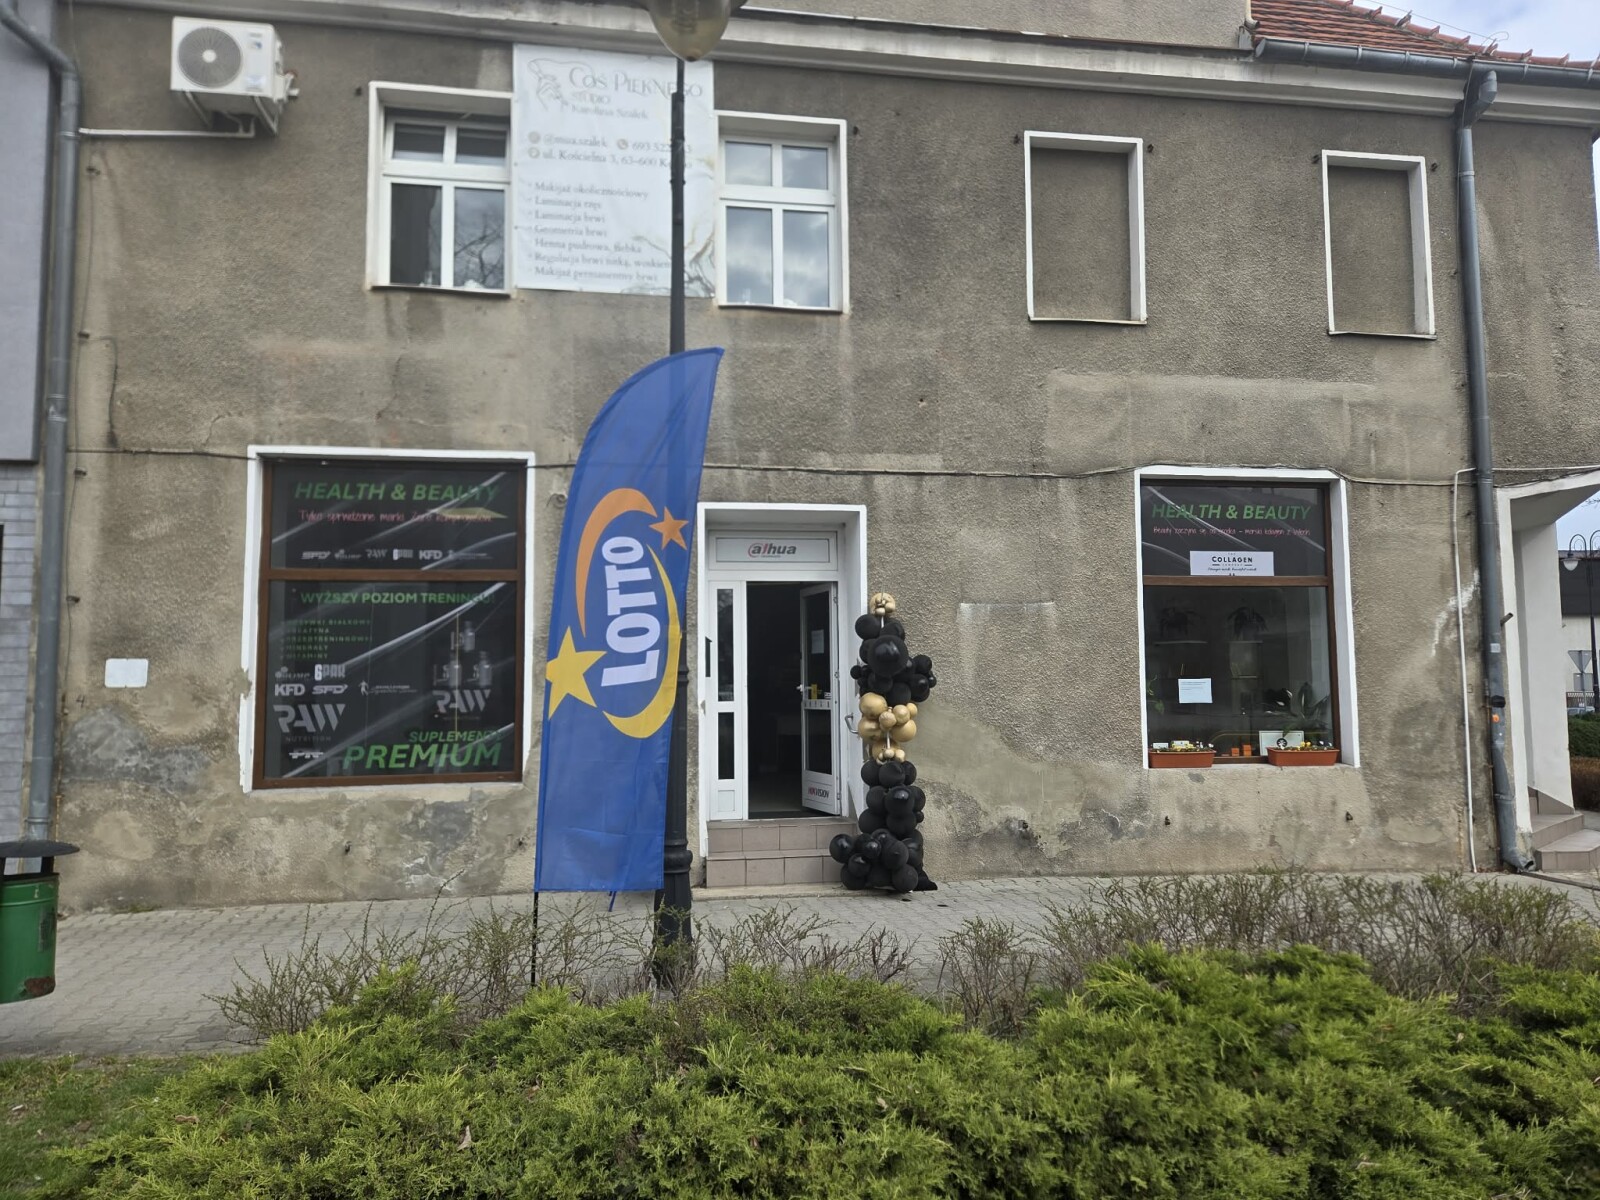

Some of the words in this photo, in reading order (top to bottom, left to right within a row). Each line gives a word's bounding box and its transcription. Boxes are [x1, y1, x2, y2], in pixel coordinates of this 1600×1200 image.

[294, 482, 385, 500] HEALTH
[391, 484, 406, 501] &
[412, 484, 499, 501] BEAUTY
[1151, 503, 1222, 519] HEALTH
[1226, 504, 1238, 519] &
[1243, 504, 1311, 520] BEAUTY
[419, 549, 443, 560] KFD
[361, 592, 417, 604] POZIOM
[601, 536, 661, 687] LOTTO
[274, 683, 305, 697] KFD
[312, 683, 348, 695] SFD
[432, 689, 491, 713] RAW
[273, 703, 346, 733] RAW
[342, 743, 502, 770] PREMIUM
